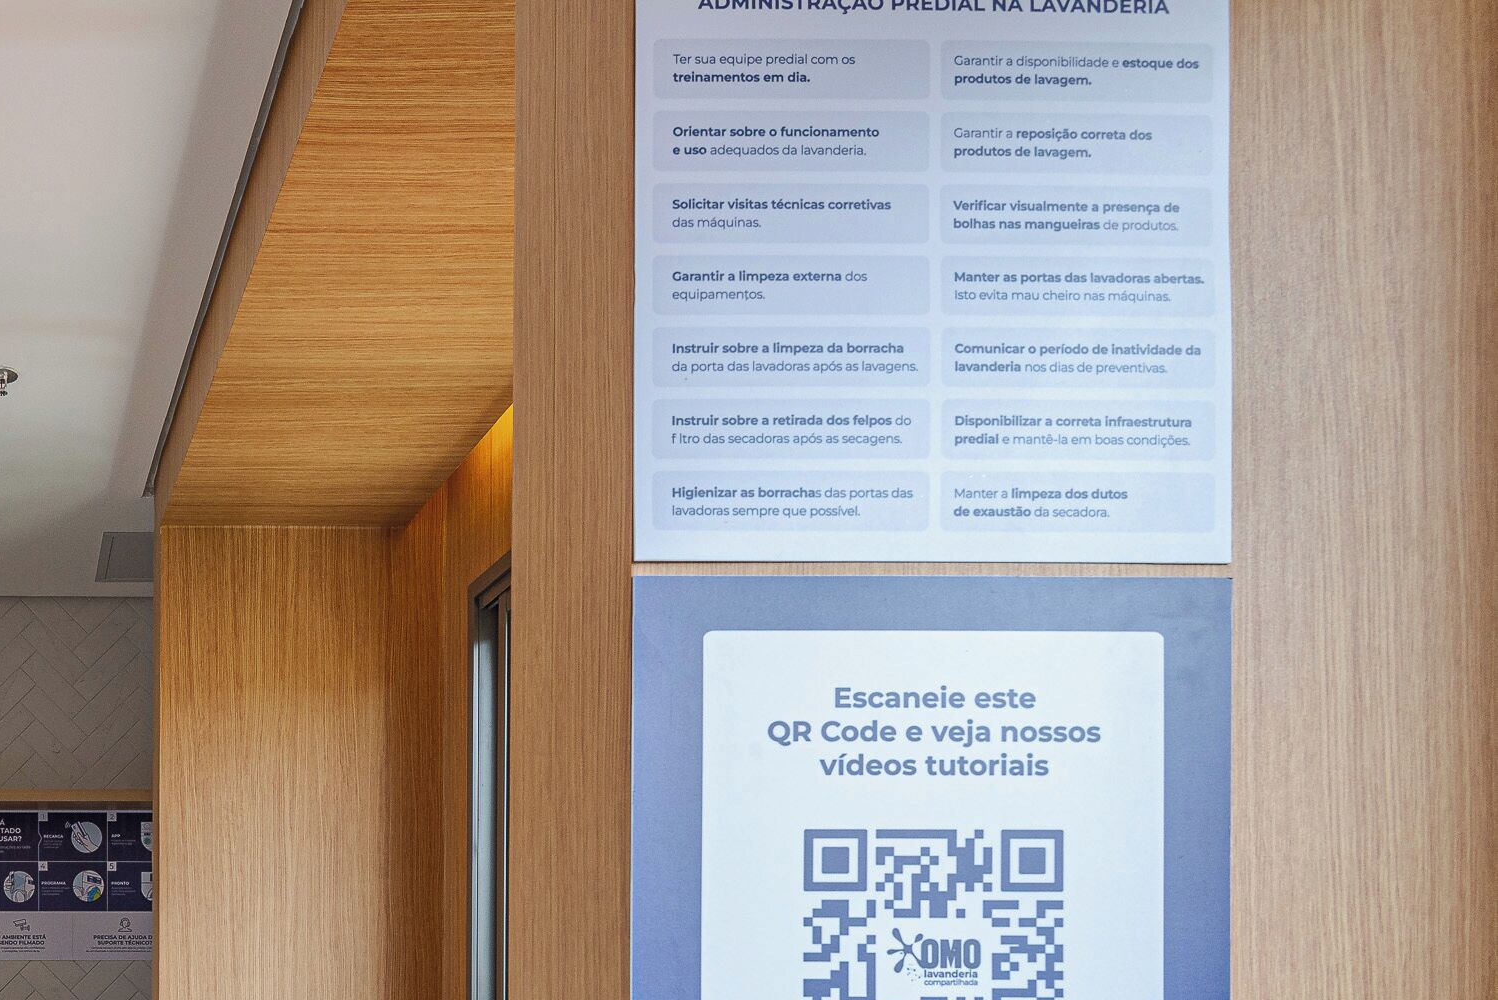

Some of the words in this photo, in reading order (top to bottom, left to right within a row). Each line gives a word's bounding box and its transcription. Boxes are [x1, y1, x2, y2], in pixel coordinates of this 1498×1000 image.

[892, 0, 985, 12] PREDIAL
[993, 0, 1023, 13] NA
[1030, 0, 1169, 14] LAVANDERIA
[672, 53, 693, 65] Ter
[694, 55, 717, 65] sua
[718, 52, 764, 68] equipe
[765, 52, 808, 67] predial
[810, 55, 839, 66] com
[840, 55, 857, 66] os
[953, 54, 1004, 67] Garantir
[1005, 57, 1014, 67] a
[1015, 55, 1110, 70] disponibilidade
[1111, 58, 1120, 69] e
[1121, 58, 1174, 72] estoque
[1175, 57, 1200, 70] dos
[672, 70, 761, 83] treinamentos
[762, 73, 785, 83] em
[786, 70, 811, 83] dia.
[953, 72, 1013, 87] produtos
[1014, 73, 1032, 86] de
[1033, 73, 1093, 88] lavagem.
[672, 125, 728, 138] Orientar
[729, 125, 767, 138] sobre
[768, 128, 778, 138] o
[779, 125, 880, 138] funcionamento
[952, 126, 1004, 140] Garantir
[1005, 129, 1014, 140] a
[1015, 127, 1079, 143] reposição
[1079, 129, 1127, 141] correta
[1128, 128, 1153, 141] dos
[953, 144, 1013, 160] produtos
[1013, 145, 1032, 158] de
[1033, 145, 1092, 161] lavagem.
[671, 197, 726, 211] Solicitar
[726, 197, 769, 210] visitas
[770, 197, 826, 211] técnicas
[827, 198, 892, 211] corretivas
[952, 198, 1008, 212] Verificar
[1008, 199, 1089, 213] visualmente
[1090, 203, 1100, 213] a
[1102, 203, 1161, 216] presença
[1163, 201, 1181, 214] de
[952, 217, 997, 230] bolhas
[998, 220, 1023, 230] nas
[1024, 217, 1101, 233] mangueiras
[1102, 221, 1120, 231] de
[1121, 220, 1178, 233] produtos.
[671, 269, 726, 283] Garantir
[727, 272, 736, 282] a
[738, 269, 790, 285] limpeza
[792, 271, 843, 282] externa
[844, 270, 868, 282] dos
[953, 271, 1001, 283] Manter
[1002, 273, 1018, 283] as
[1019, 272, 1063, 286] portas
[1063, 271, 1088, 284] das
[1089, 271, 1152, 284] lavadoras
[1153, 272, 1205, 285] abertas.
[671, 287, 766, 303] equipamentos.
[671, 341, 720, 355] Instruir
[721, 341, 760, 354] sobre
[761, 344, 770, 354] a
[772, 341, 824, 357] limpeza
[826, 341, 844, 354] da
[846, 341, 905, 354] borracha
[953, 341, 1026, 355] Comunicar
[1027, 345, 1038, 355] o
[1039, 343, 1090, 358] período
[1091, 343, 1109, 356] de
[1110, 342, 1183, 356] inatividade
[1184, 344, 1202, 357] da
[954, 413, 1043, 430] Disponibilizar
[1044, 417, 1053, 427] a
[1055, 416, 1103, 428] correta
[1104, 414, 1193, 429] infraestrutura
[671, 485, 739, 501] Higienizar
[739, 488, 756, 499] as
[757, 486, 823, 499] borrachas
[823, 486, 847, 499] das
[848, 488, 889, 501] portas
[890, 487, 914, 499] das
[953, 487, 999, 500] Manter
[1000, 489, 1009, 500] a
[1010, 486, 1063, 502] limpeza
[1064, 487, 1090, 500] dos
[1090, 487, 1129, 500] dutos
[671, 504, 731, 517] lavadoras
[731, 506, 781, 519] sempre
[781, 507, 808, 519] que
[809, 504, 861, 519] possível.
[952, 505, 971, 518] de
[972, 505, 1033, 518] exaustão
[1033, 505, 1050, 518] da
[1051, 505, 1111, 519] secadora.
[834, 684, 966, 710] Escaneie
[973, 688, 1037, 710] este
[766, 719, 813, 748] QR
[820, 719, 898, 743] Code
[904, 724, 924, 743] e
[930, 718, 991, 749] veja
[1000, 725, 1102, 744] nossos
[818, 752, 918, 777] vídeos
[924, 752, 1050, 777] tutoriais
[919, 939, 980, 969] OMO
[924, 969, 978, 978] lavanderia
